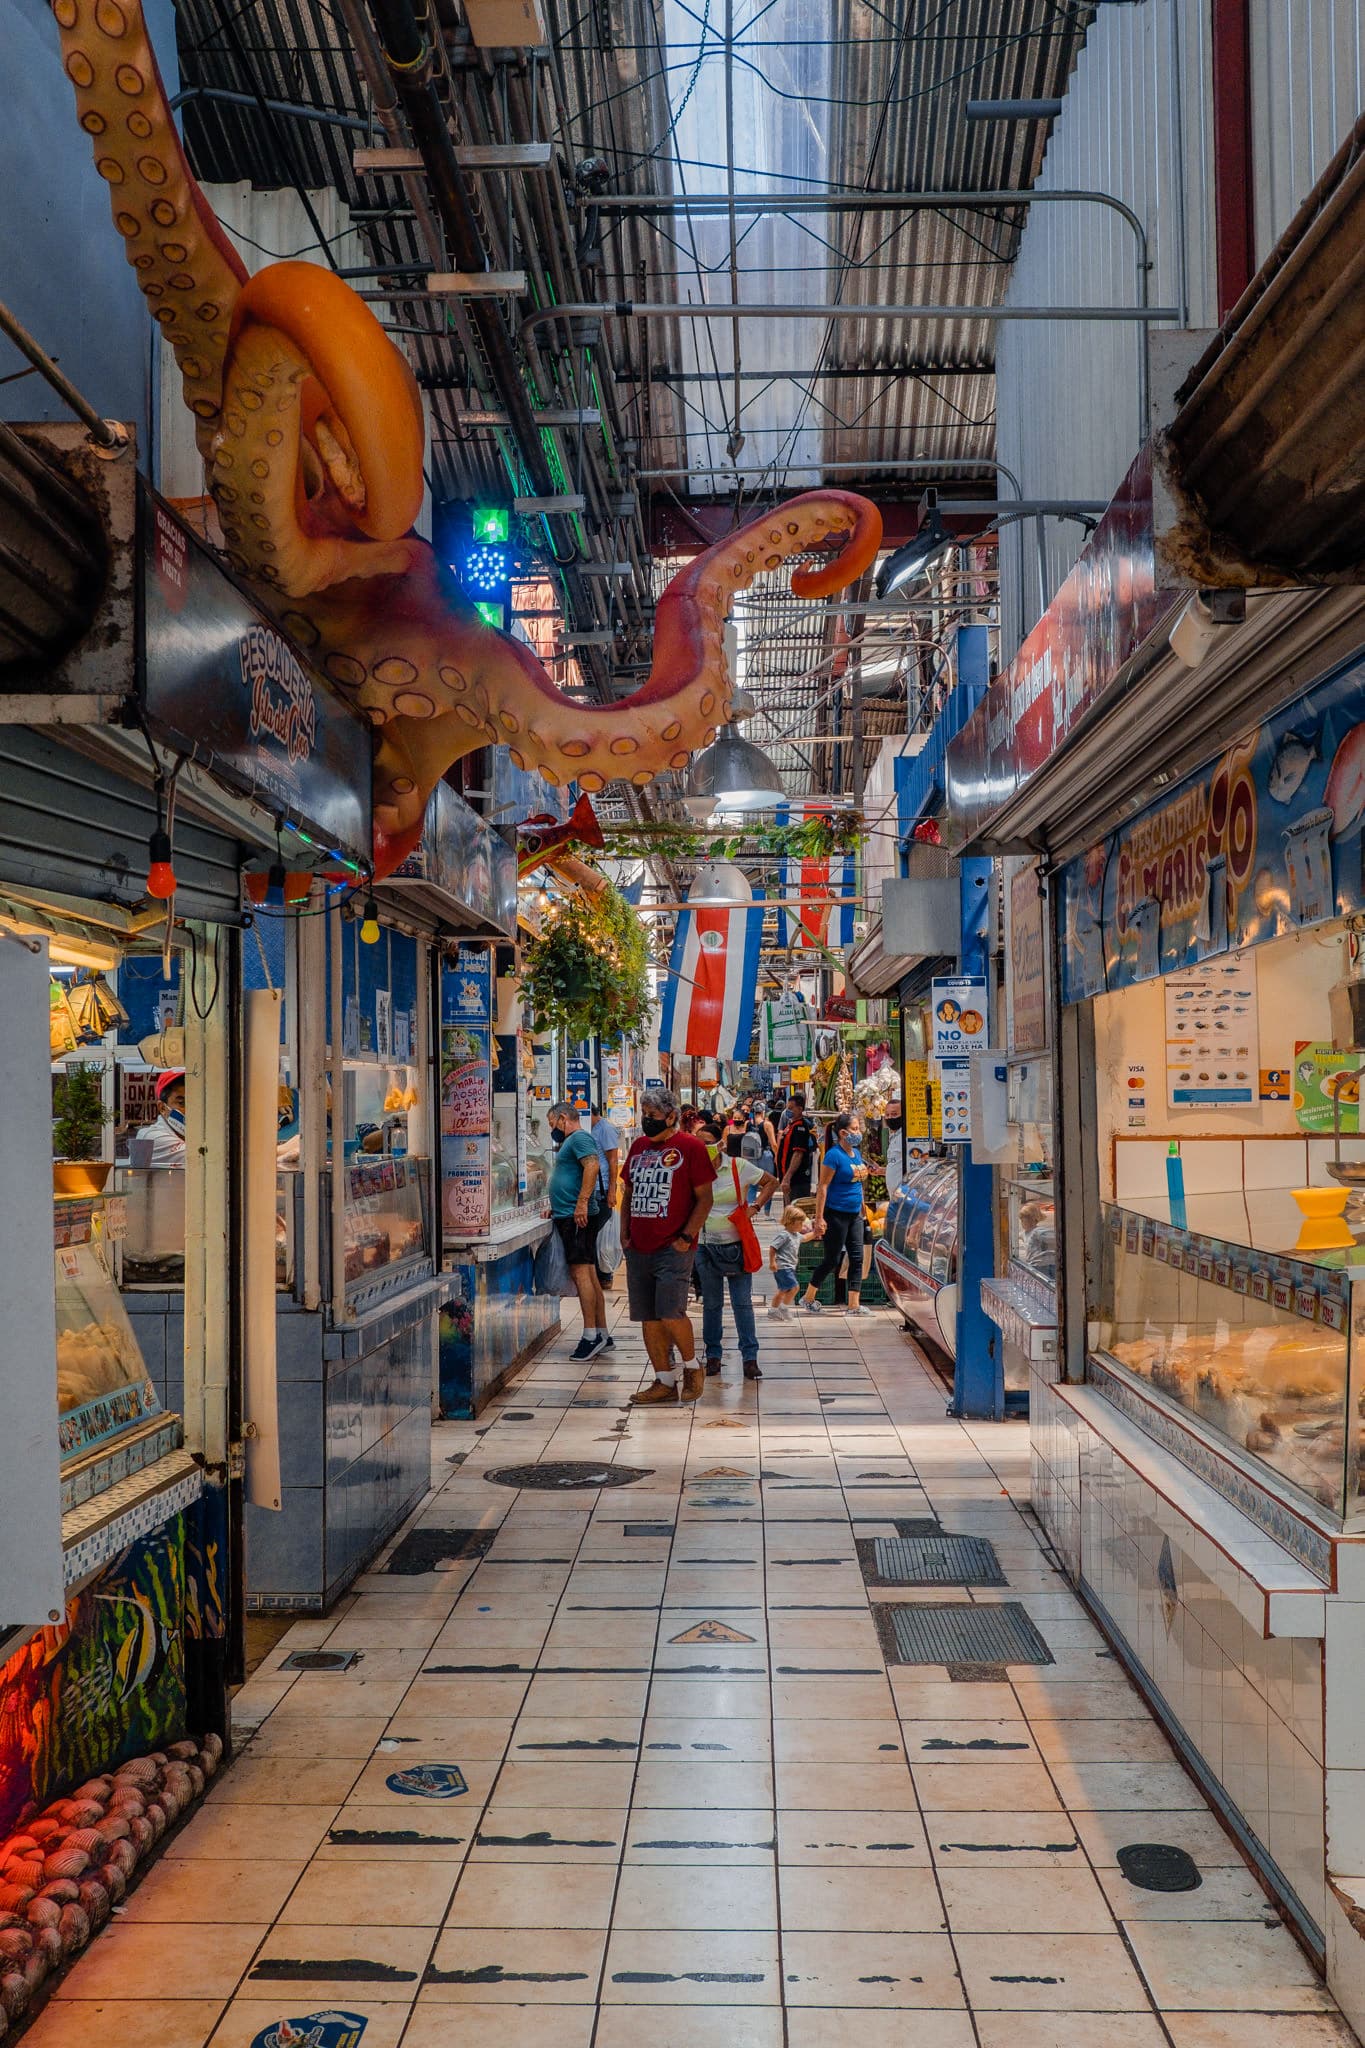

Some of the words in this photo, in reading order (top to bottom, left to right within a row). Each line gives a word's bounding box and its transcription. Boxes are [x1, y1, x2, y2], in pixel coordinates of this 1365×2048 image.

[157, 510, 186, 552] GRACIAS
[937, 1030, 962, 1041] NO
[1128, 1065, 1145, 1073] VISA
